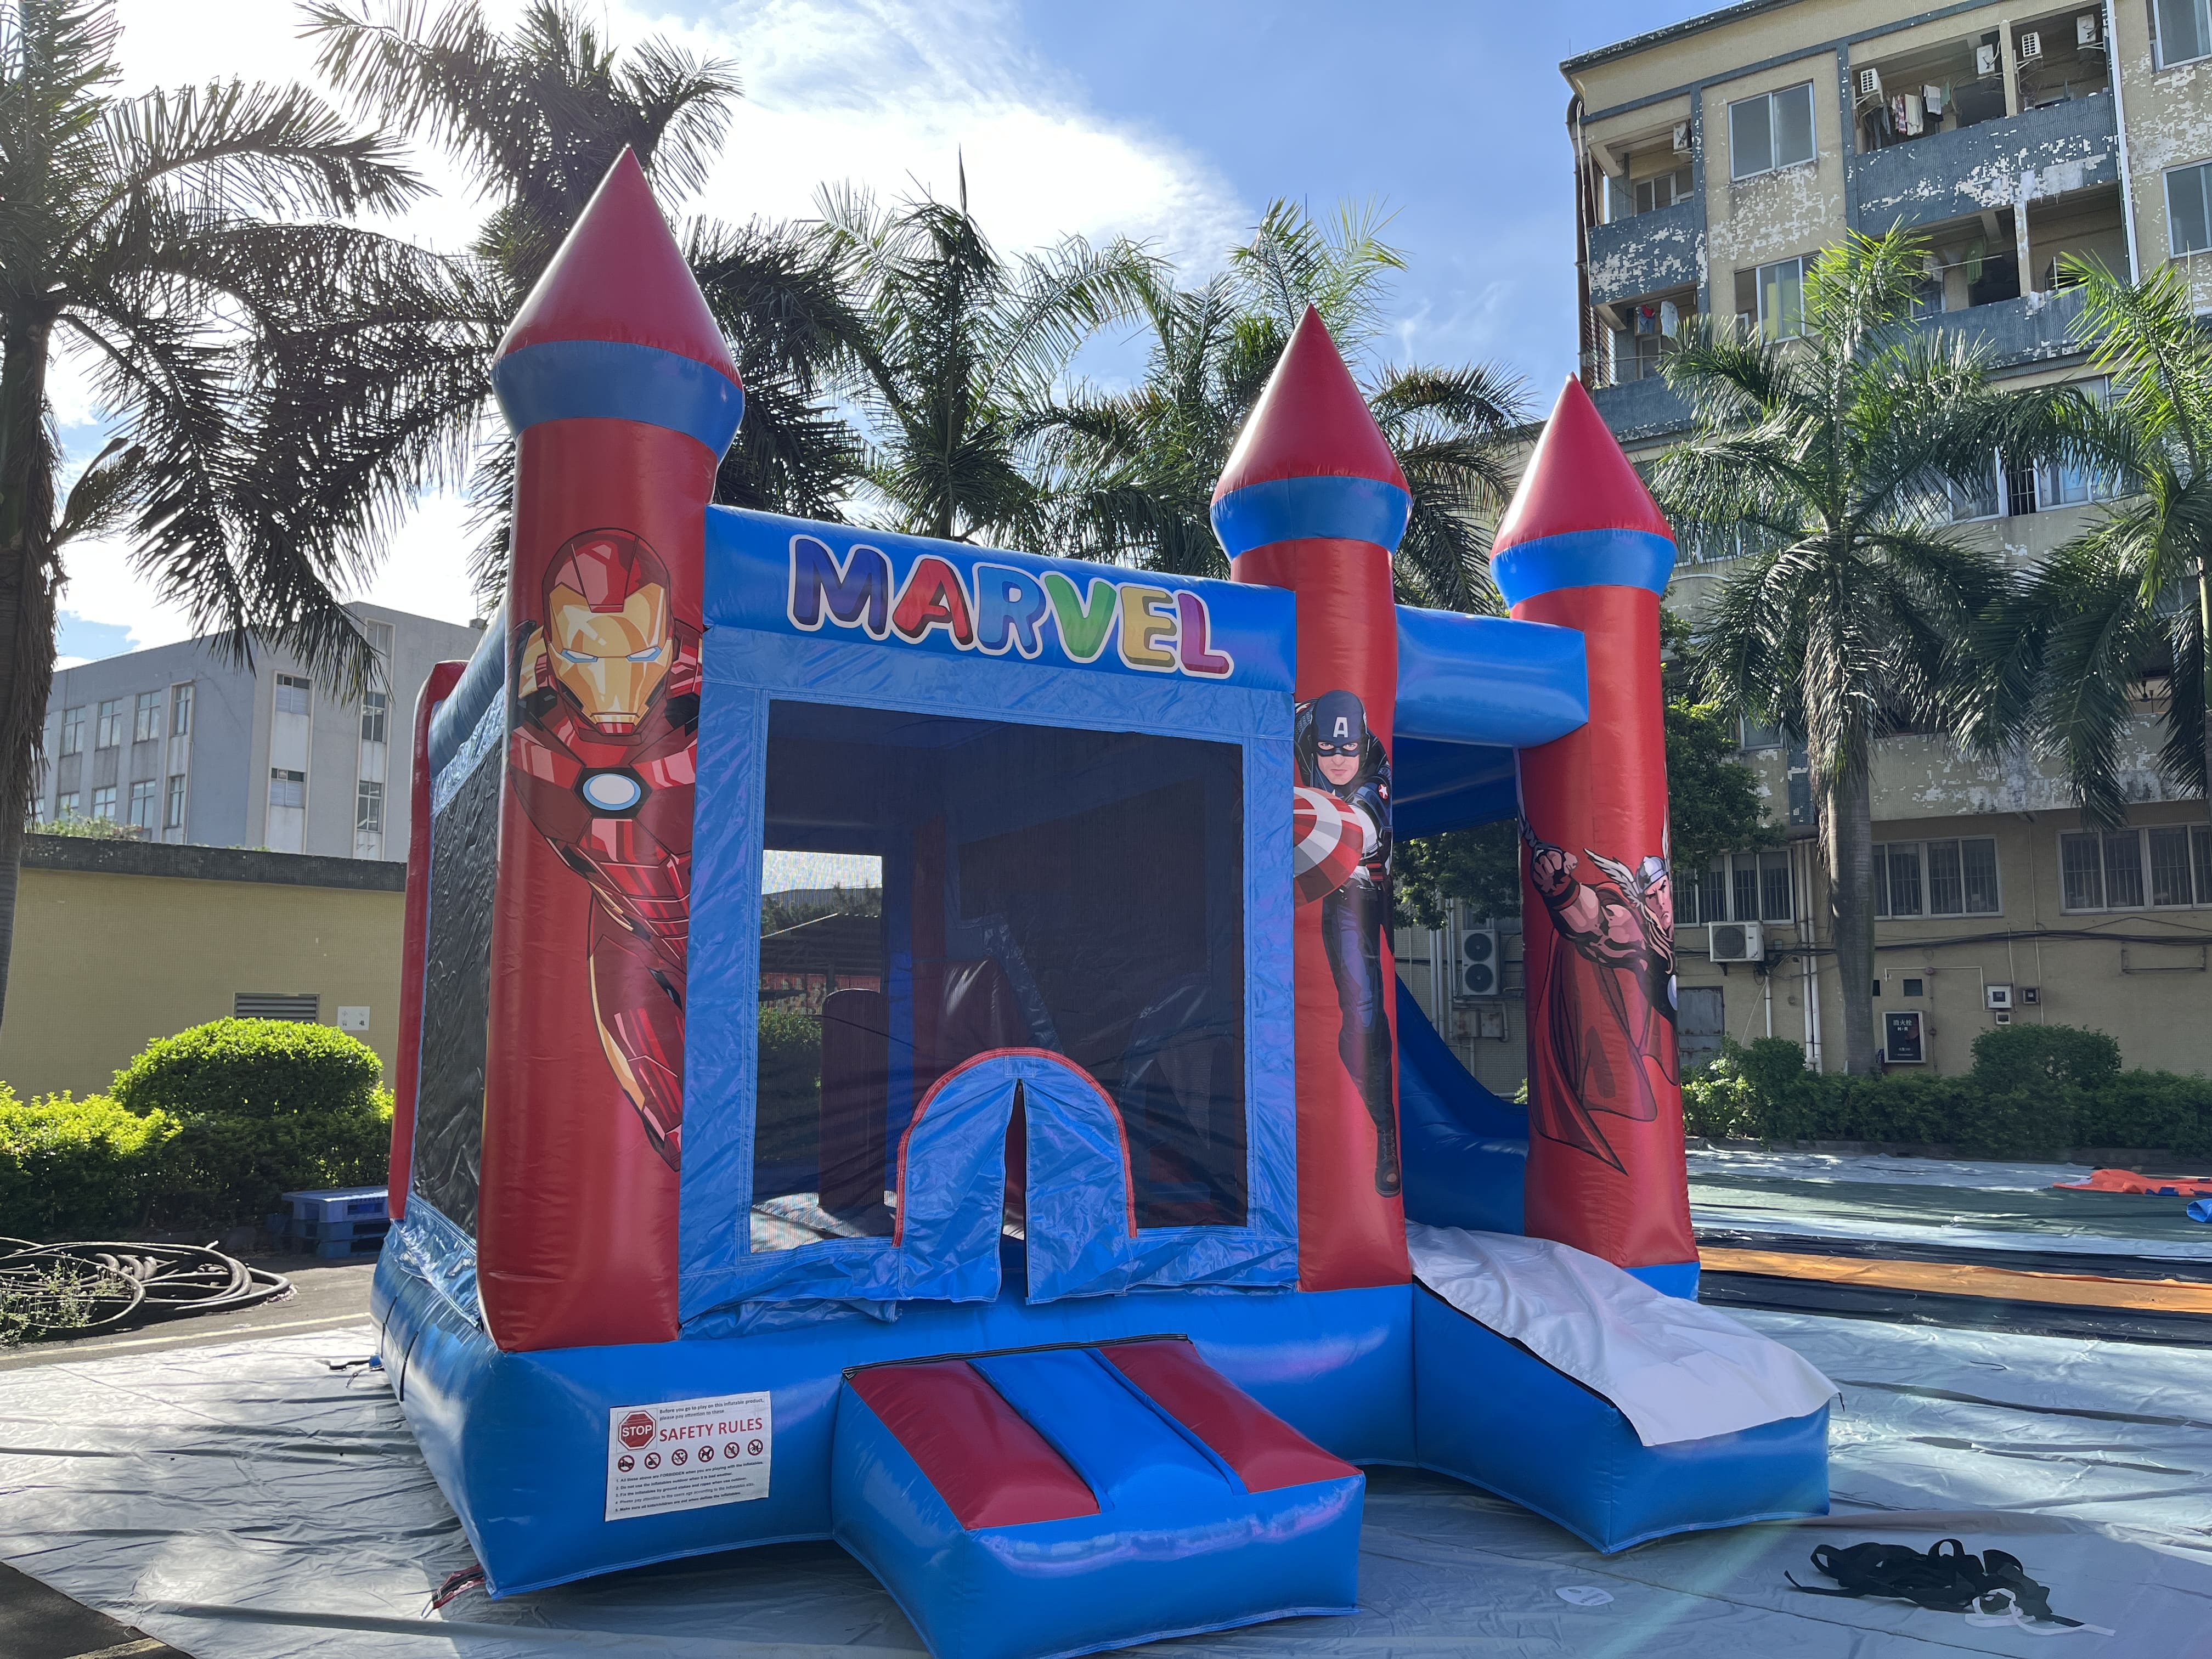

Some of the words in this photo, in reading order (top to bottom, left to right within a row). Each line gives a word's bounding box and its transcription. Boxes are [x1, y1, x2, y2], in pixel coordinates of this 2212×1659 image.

[788, 534, 1233, 679] MARVEL
[1333, 716, 1348, 738] A
[622, 1425, 652, 1437] STOP
[659, 1424, 713, 1442] SAFETY
[719, 1418, 763, 1435] RULES
